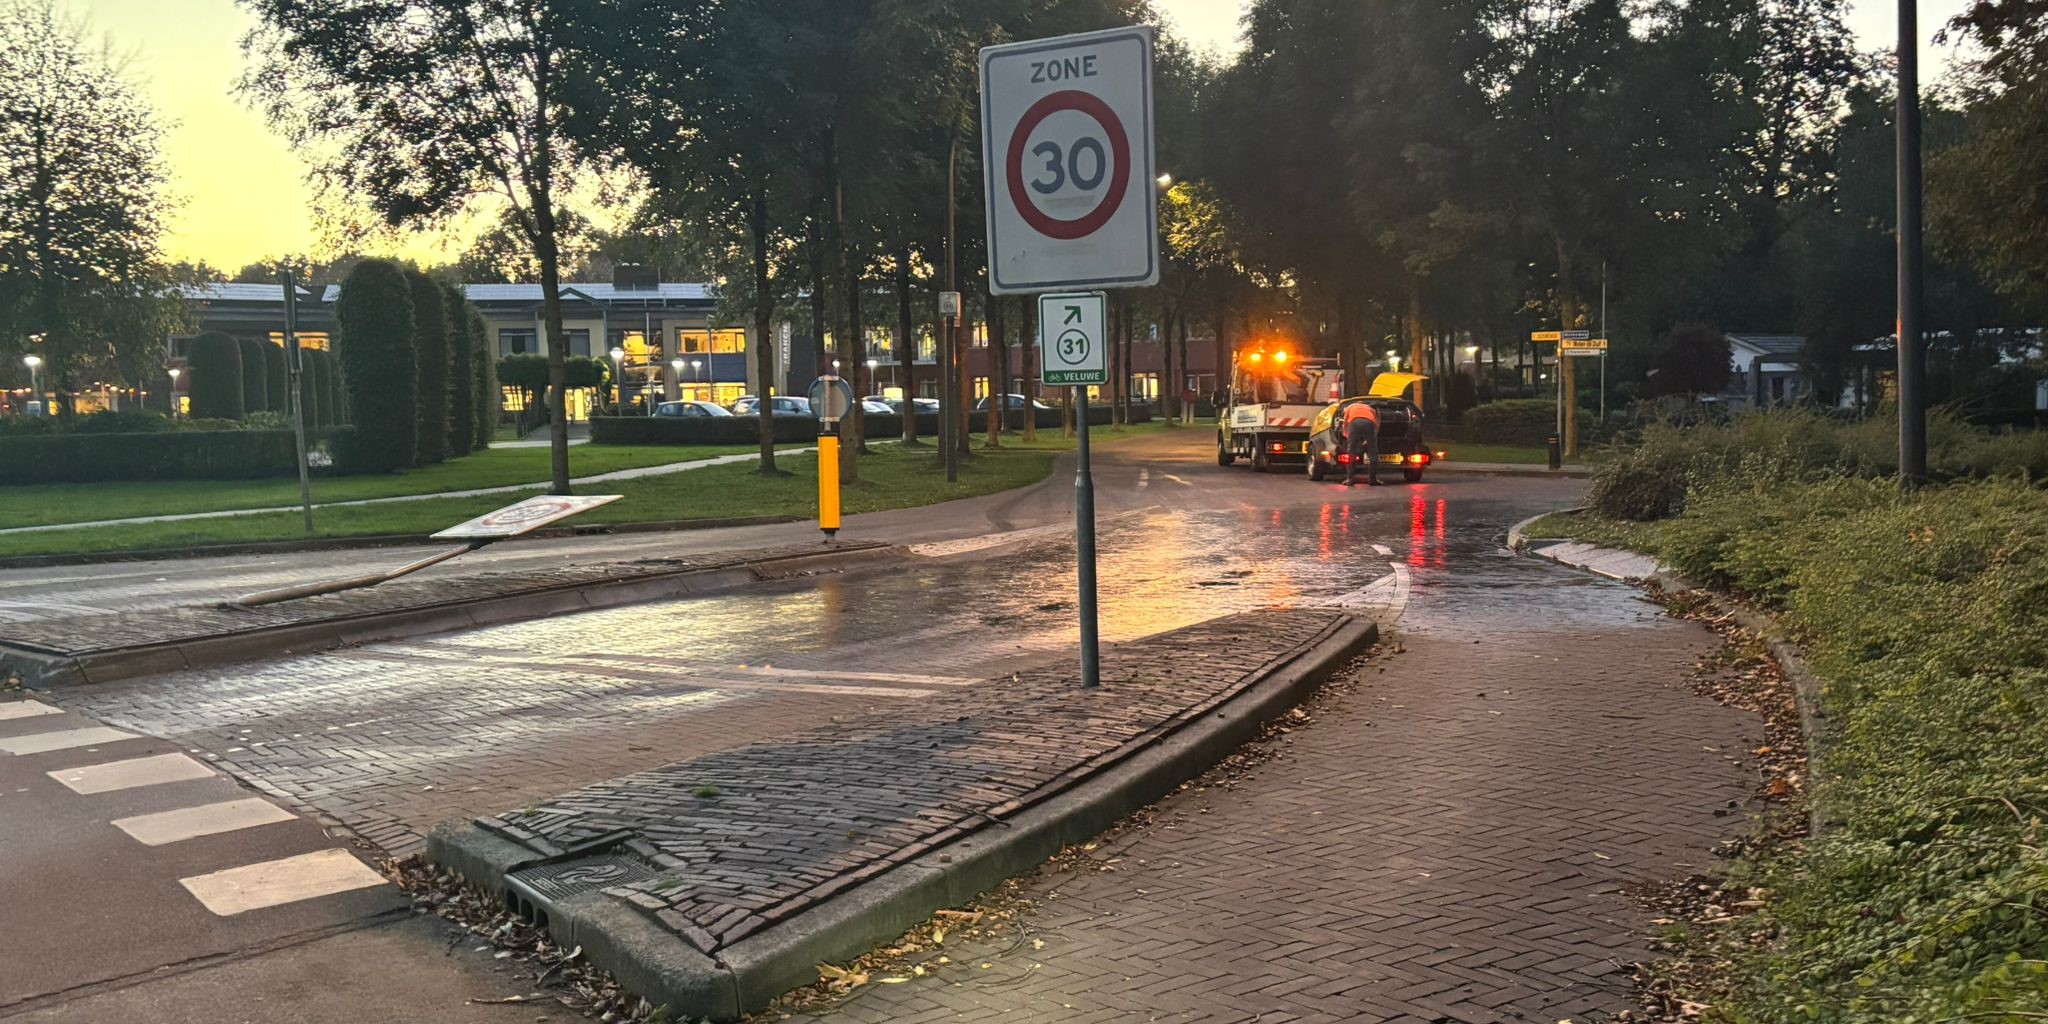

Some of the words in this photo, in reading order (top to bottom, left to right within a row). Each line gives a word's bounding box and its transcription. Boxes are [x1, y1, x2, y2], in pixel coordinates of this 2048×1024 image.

[1030, 54, 1098, 84] ZONE
[1030, 136, 1106, 194] 30
[1063, 338, 1085, 355] 31
[1063, 371, 1100, 381] VELUWE
